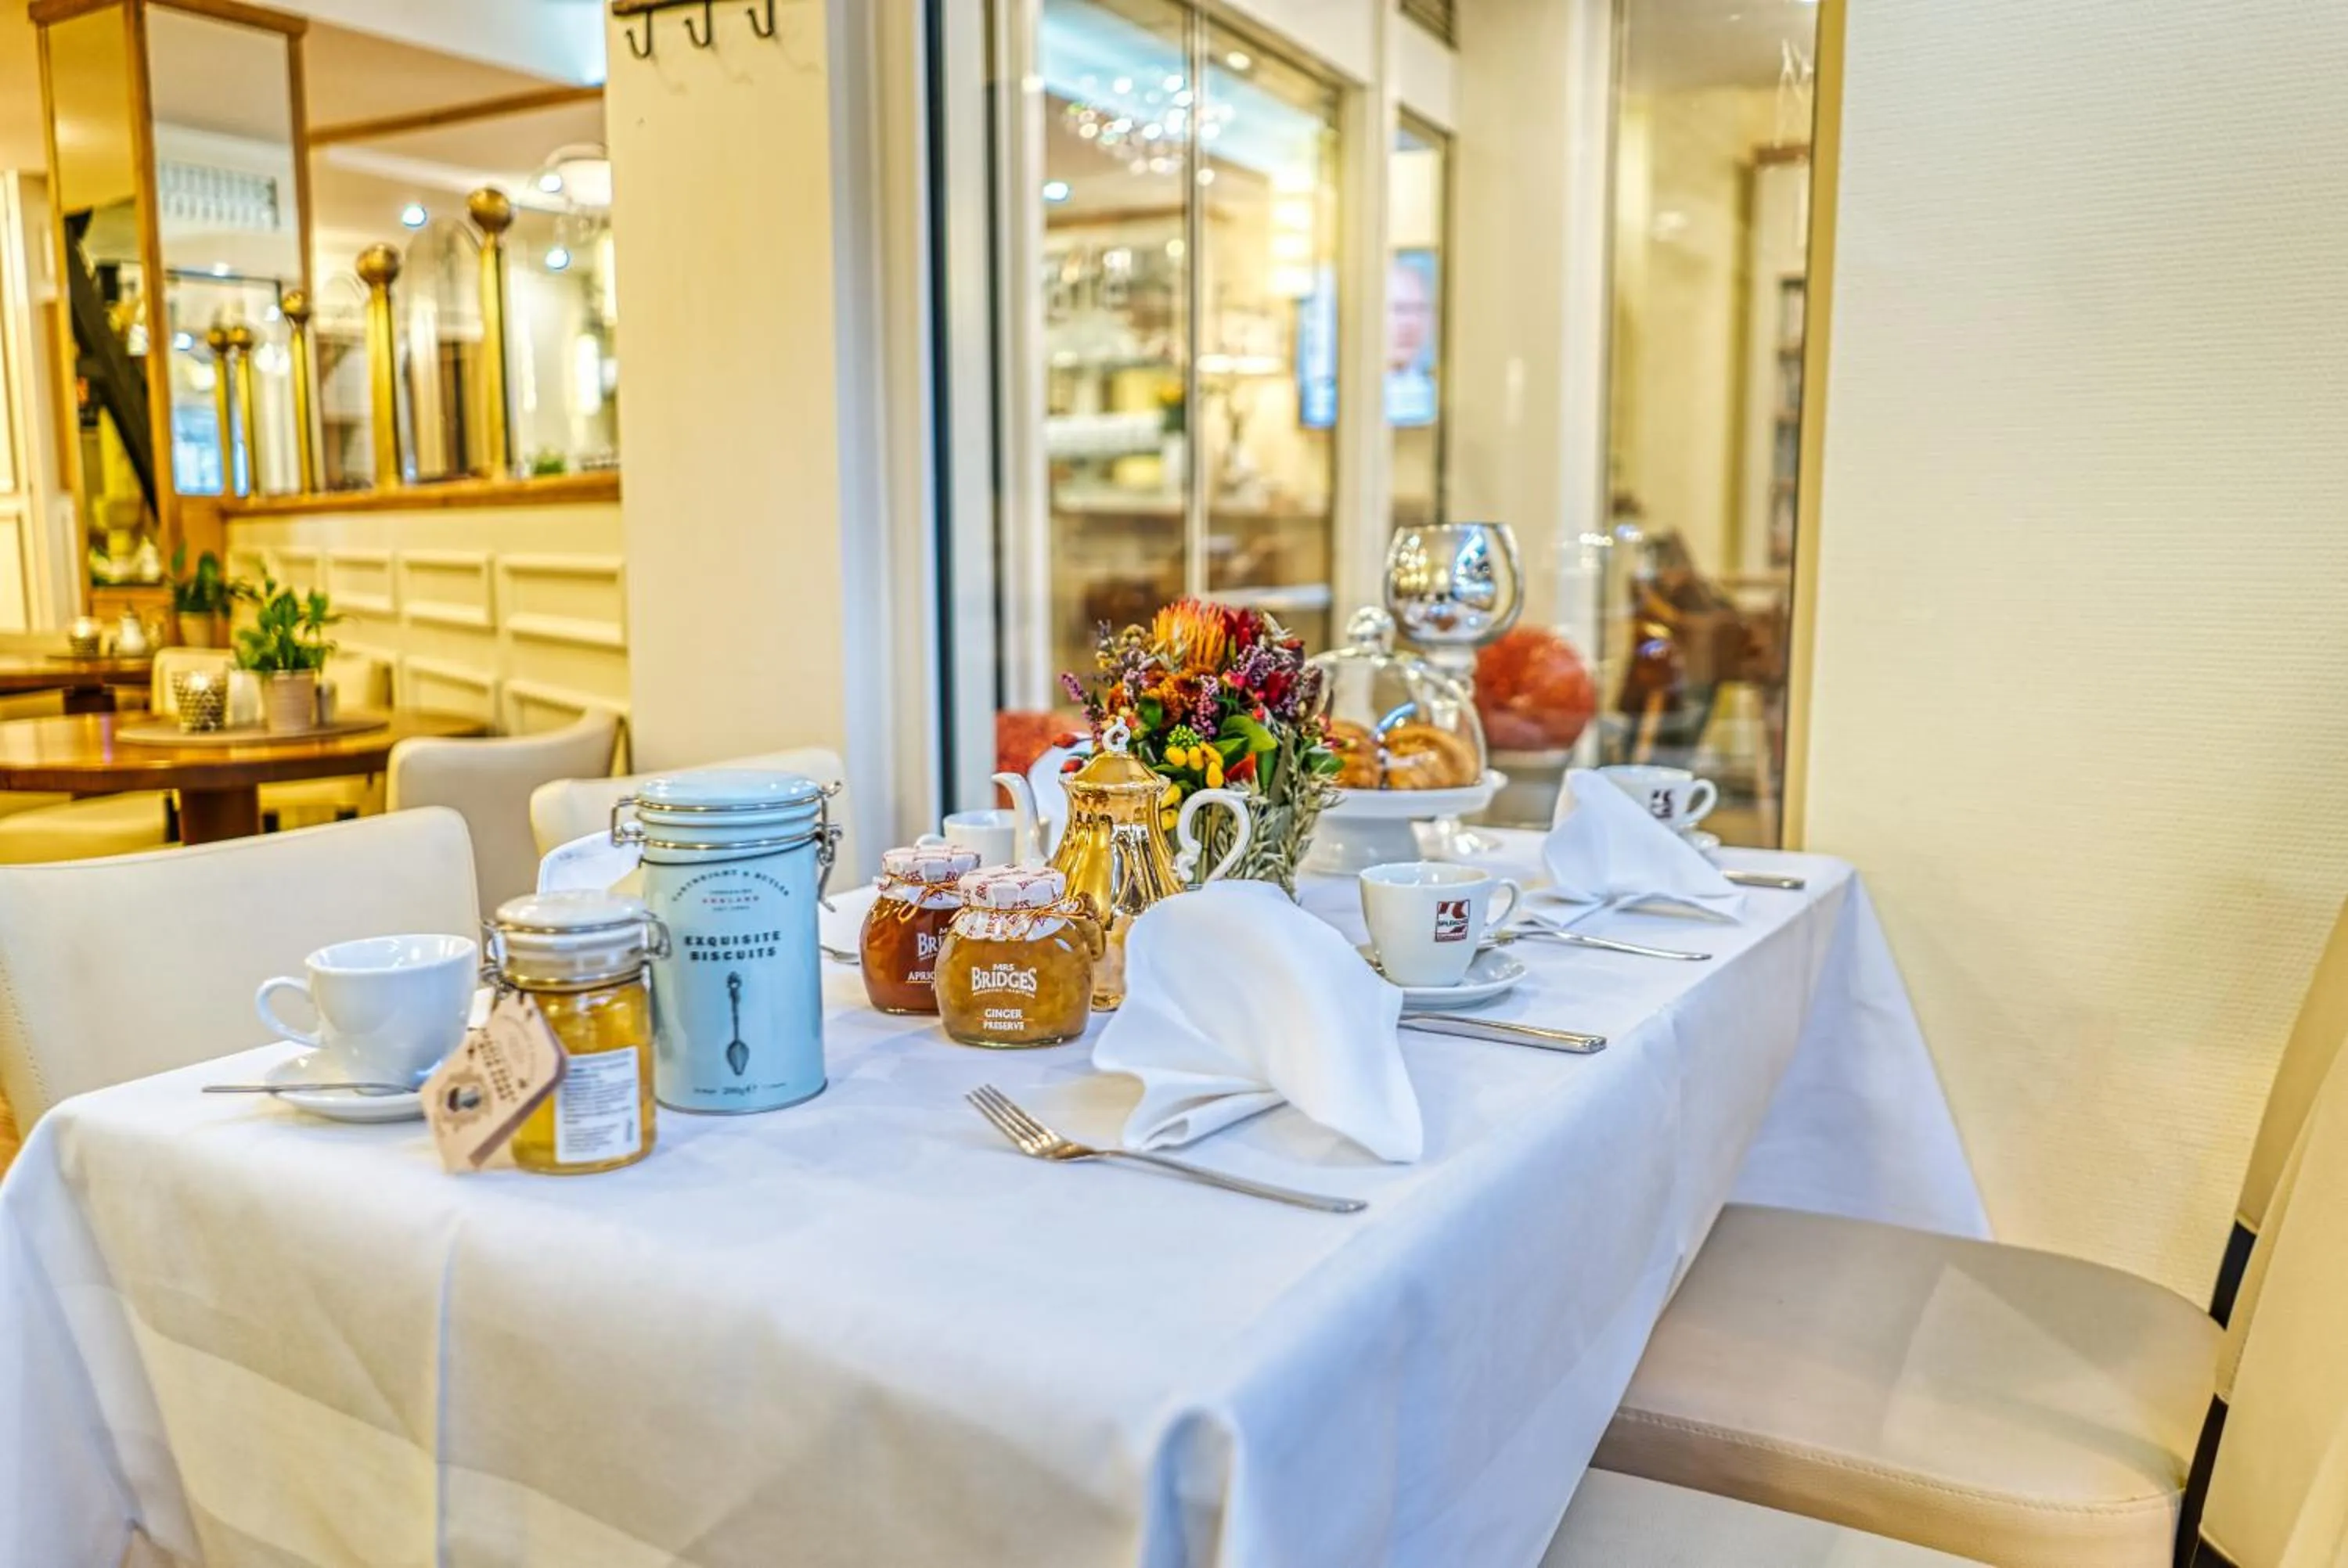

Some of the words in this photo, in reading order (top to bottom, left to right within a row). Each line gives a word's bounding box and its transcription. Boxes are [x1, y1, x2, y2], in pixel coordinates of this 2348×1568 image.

[684, 930, 780, 948] EXQUISITE
[917, 932, 943, 957] BRI
[690, 946, 777, 962] BISCUITS
[908, 970, 935, 980] APRIC
[971, 966, 1037, 993] BRIDGES
[985, 1008, 1023, 1019] GINGER
[983, 1020, 1025, 1030] PRESERVE
